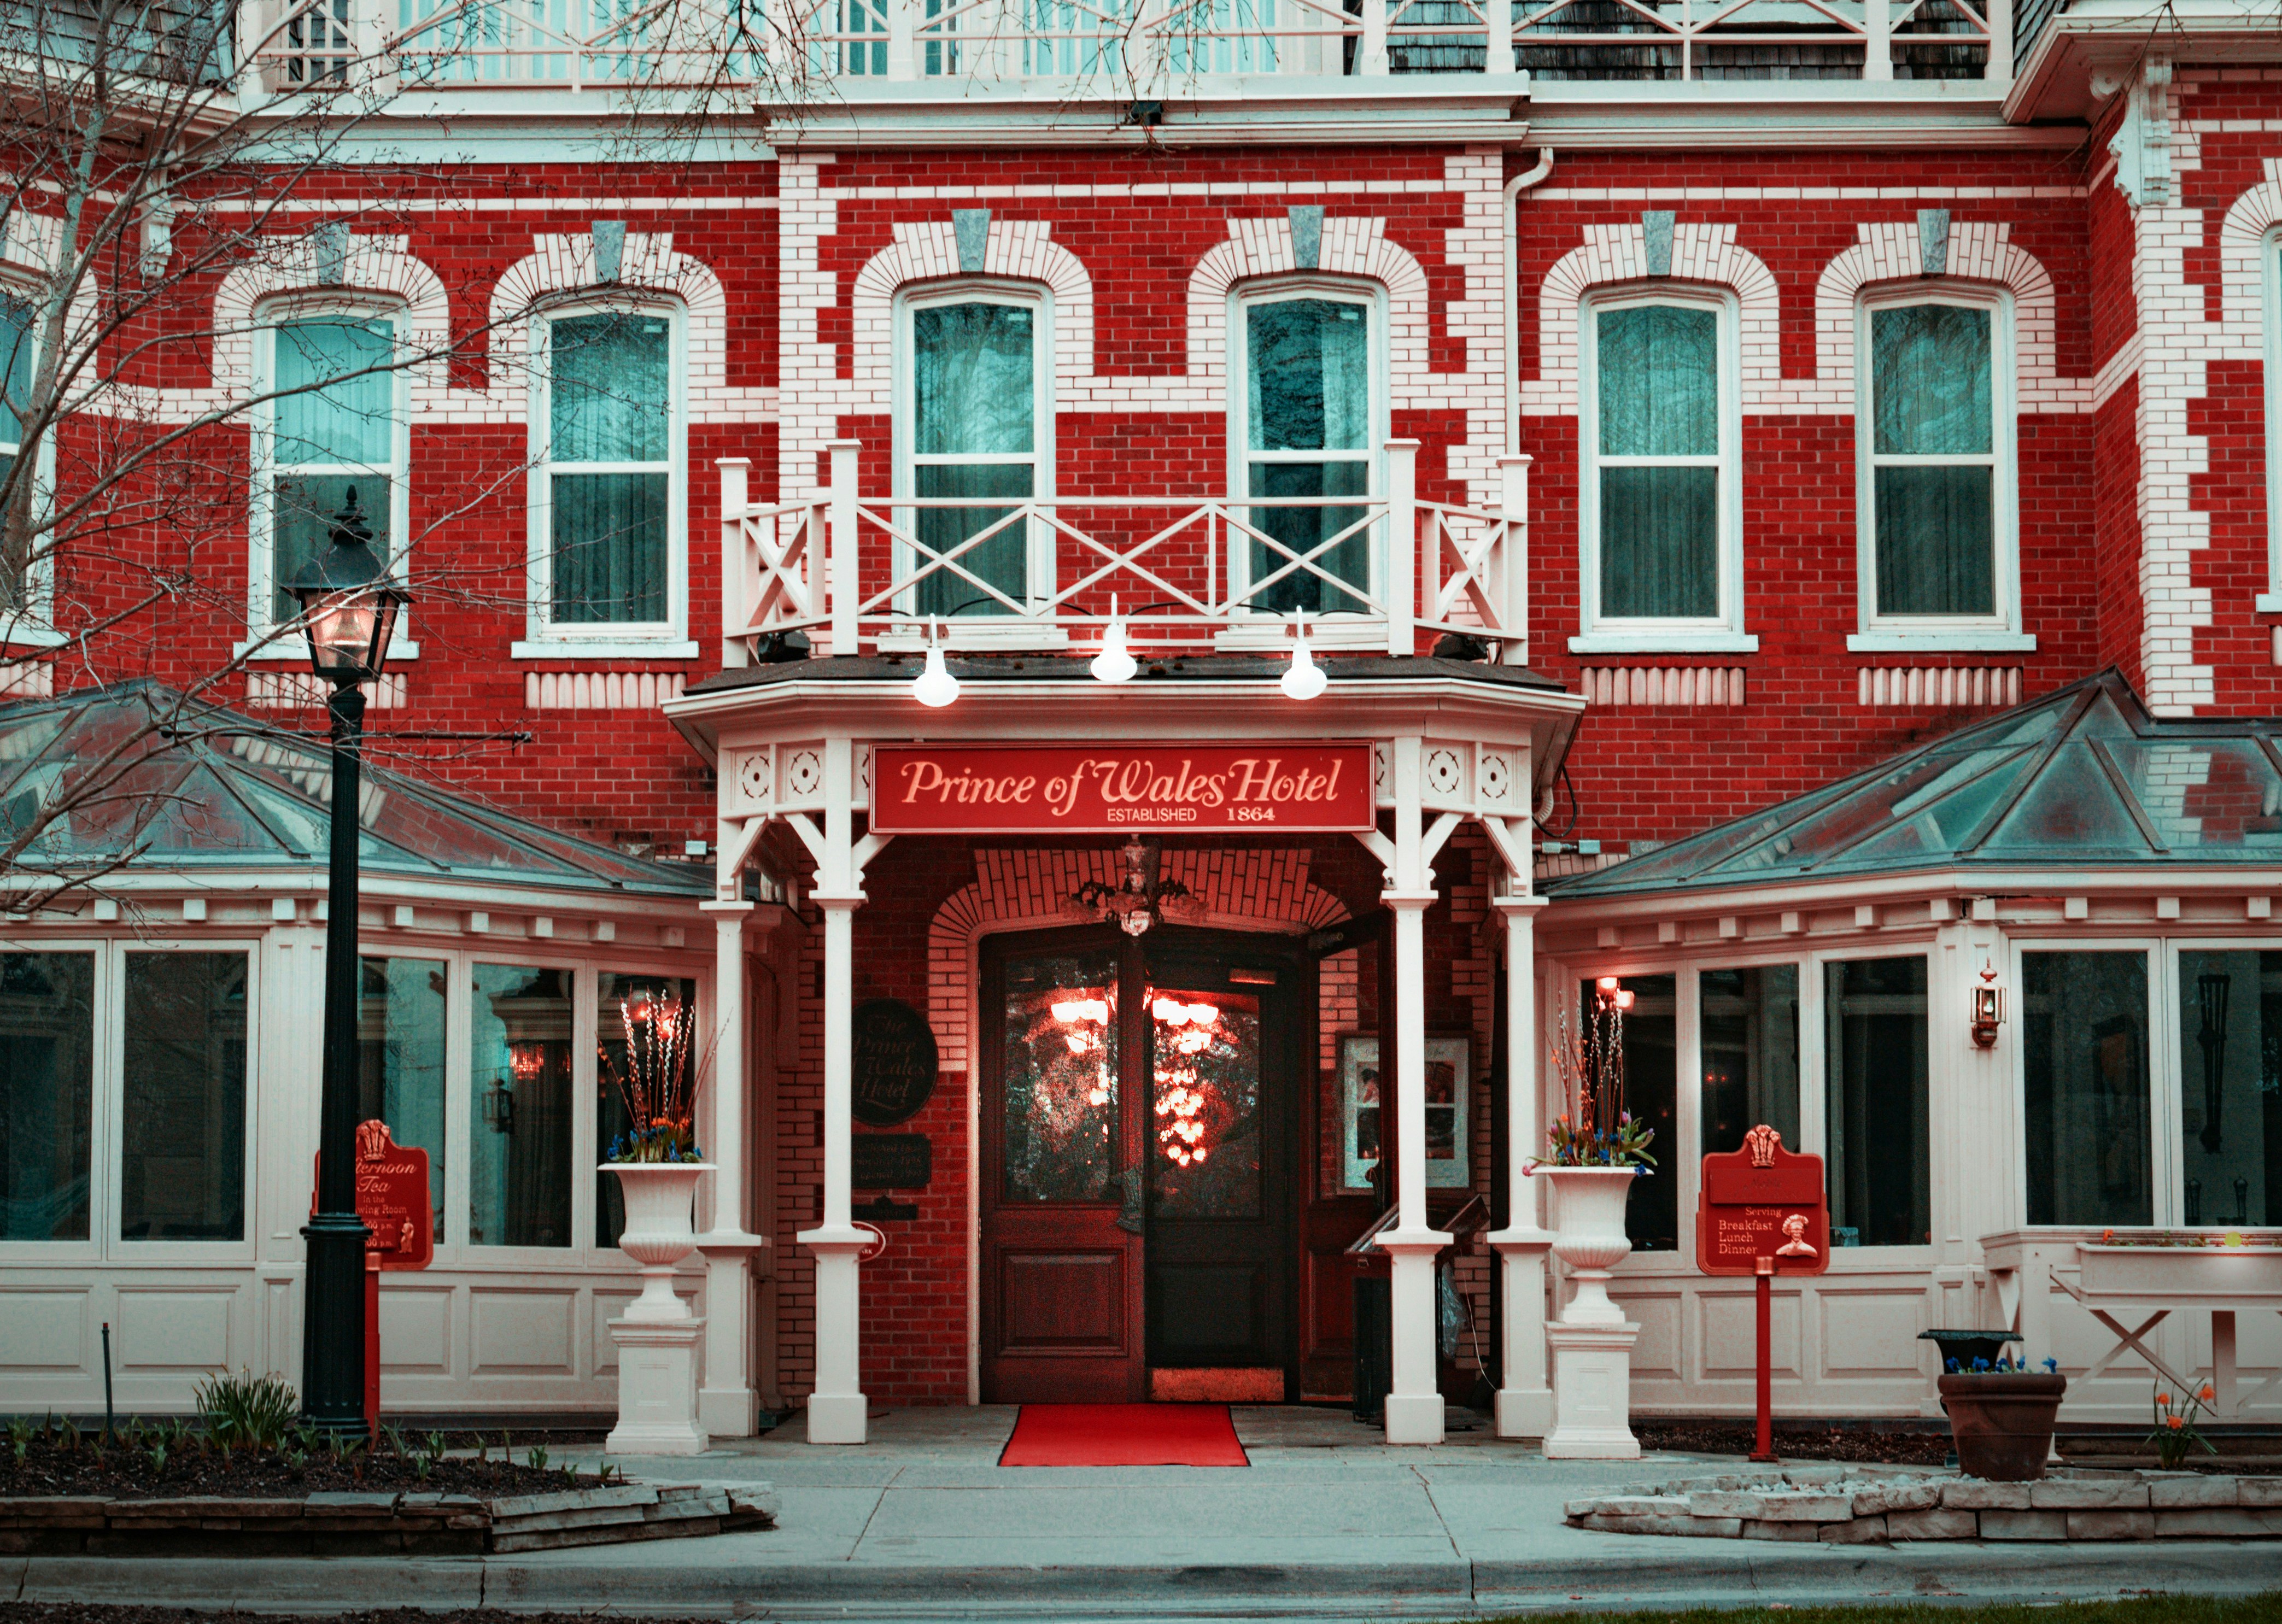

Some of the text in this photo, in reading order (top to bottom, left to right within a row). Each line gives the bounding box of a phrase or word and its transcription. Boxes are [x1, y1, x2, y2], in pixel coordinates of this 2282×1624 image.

[901, 759, 1343, 816] Prince of Wales Hotel
[1107, 807, 1275, 822] ESTABLISHED 1864
[355, 1157, 417, 1174] ternoon
[357, 1176, 392, 1192] Tea
[356, 1204, 407, 1216] wing Room
[1745, 1206, 1782, 1218] Serving
[1719, 1220, 1773, 1230] Breakfast
[1719, 1232, 1753, 1242] Lunch
[1719, 1244, 1758, 1254] Dinner
